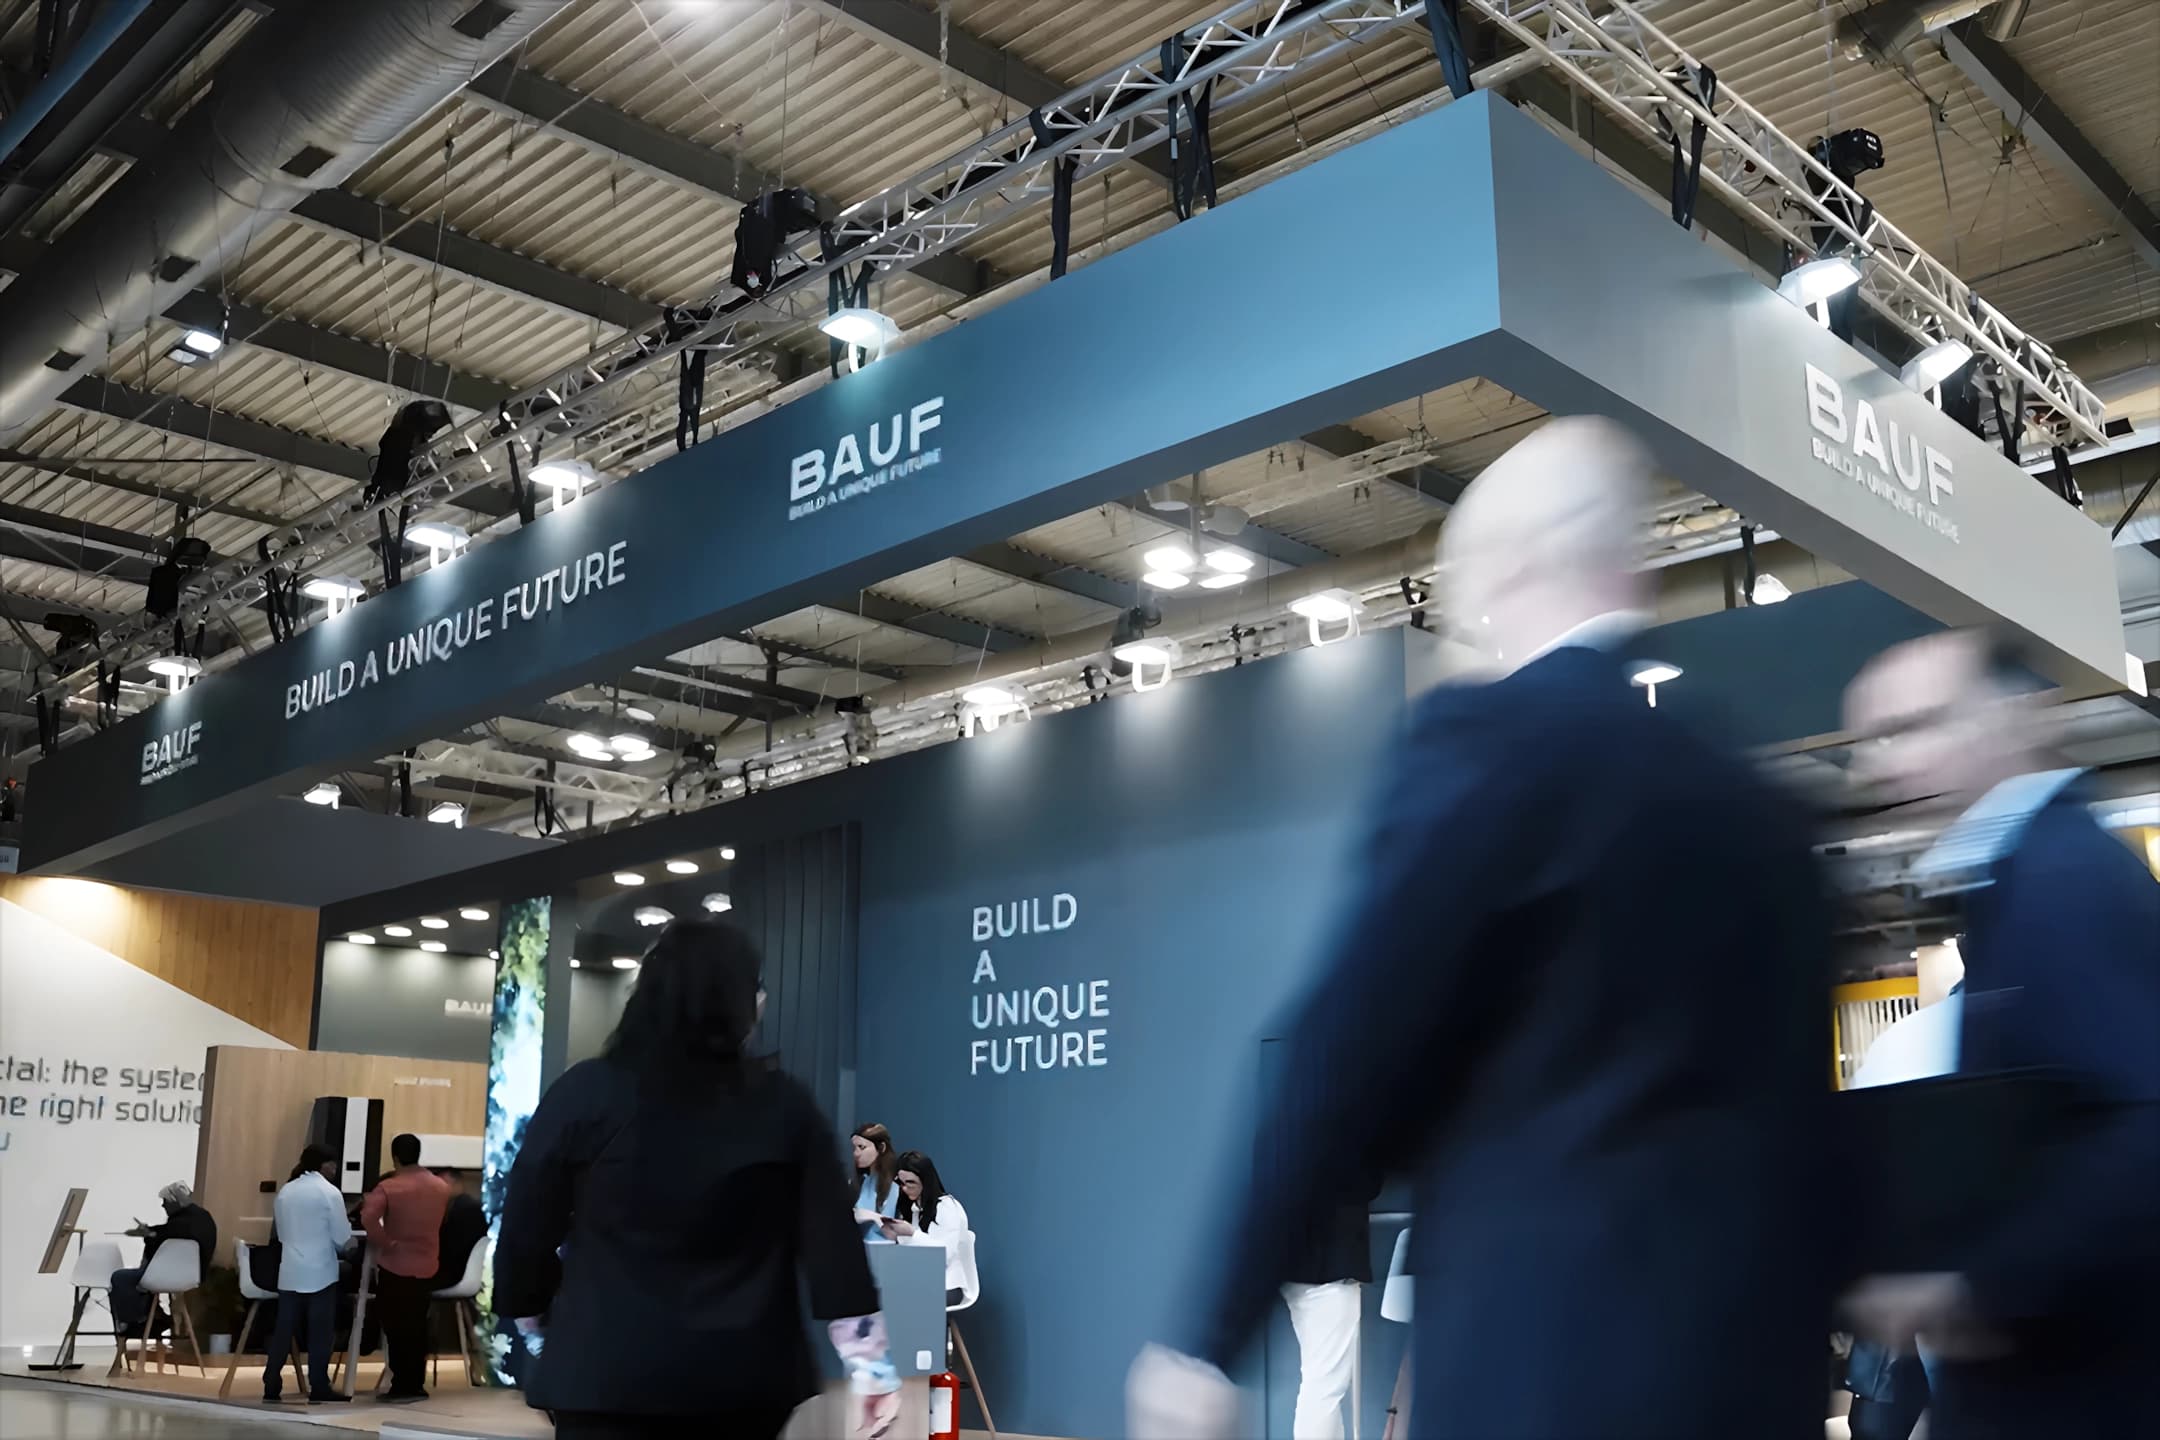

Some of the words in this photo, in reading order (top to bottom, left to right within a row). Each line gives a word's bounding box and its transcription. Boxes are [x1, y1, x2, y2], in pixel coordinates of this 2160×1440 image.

[790, 396, 945, 501] BAUF
[1804, 361, 1954, 506] BAUF
[1811, 437, 1853, 477] BUILD
[1855, 465, 1866, 487] A
[788, 496, 826, 520] BUILD
[827, 491, 838, 506] A
[285, 660, 355, 719] BUILD
[360, 650, 379, 688] A
[387, 598, 494, 675] UNIQUE
[502, 540, 627, 630] FUTURE
[142, 720, 202, 773] BAUF
[972, 893, 1078, 942] BUILD
[972, 949, 997, 984] A
[972, 979, 1110, 1029] UNIQUE
[0, 1055, 50, 1083] tal:
[62, 1058, 109, 1087] the
[970, 1029, 1108, 1076] FUTURE
[39, 1092, 105, 1125] right
